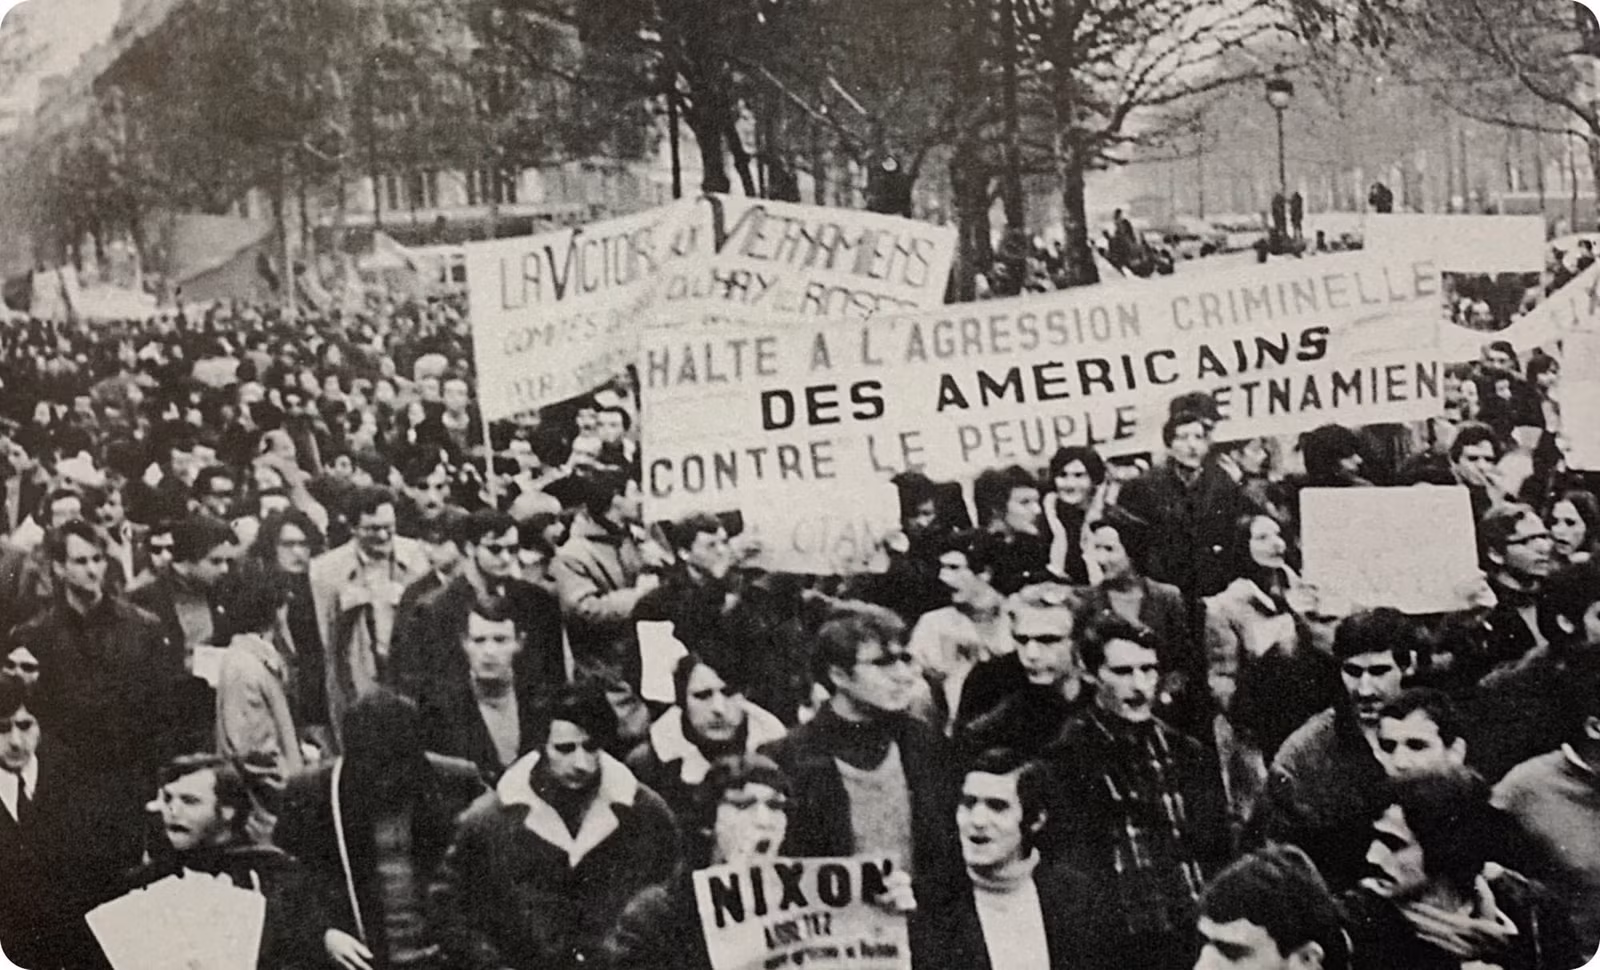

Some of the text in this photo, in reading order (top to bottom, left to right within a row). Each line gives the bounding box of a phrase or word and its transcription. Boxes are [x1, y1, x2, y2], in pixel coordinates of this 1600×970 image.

[647, 336, 778, 387] HALTE
[810, 331, 832, 370] A
[1171, 260, 1438, 333] CRIMINELLE
[649, 361, 1439, 498] CONTRE LE PEUPLE ETNAMIEN
[760, 380, 886, 431] DES
[708, 858, 893, 928] NIXON
